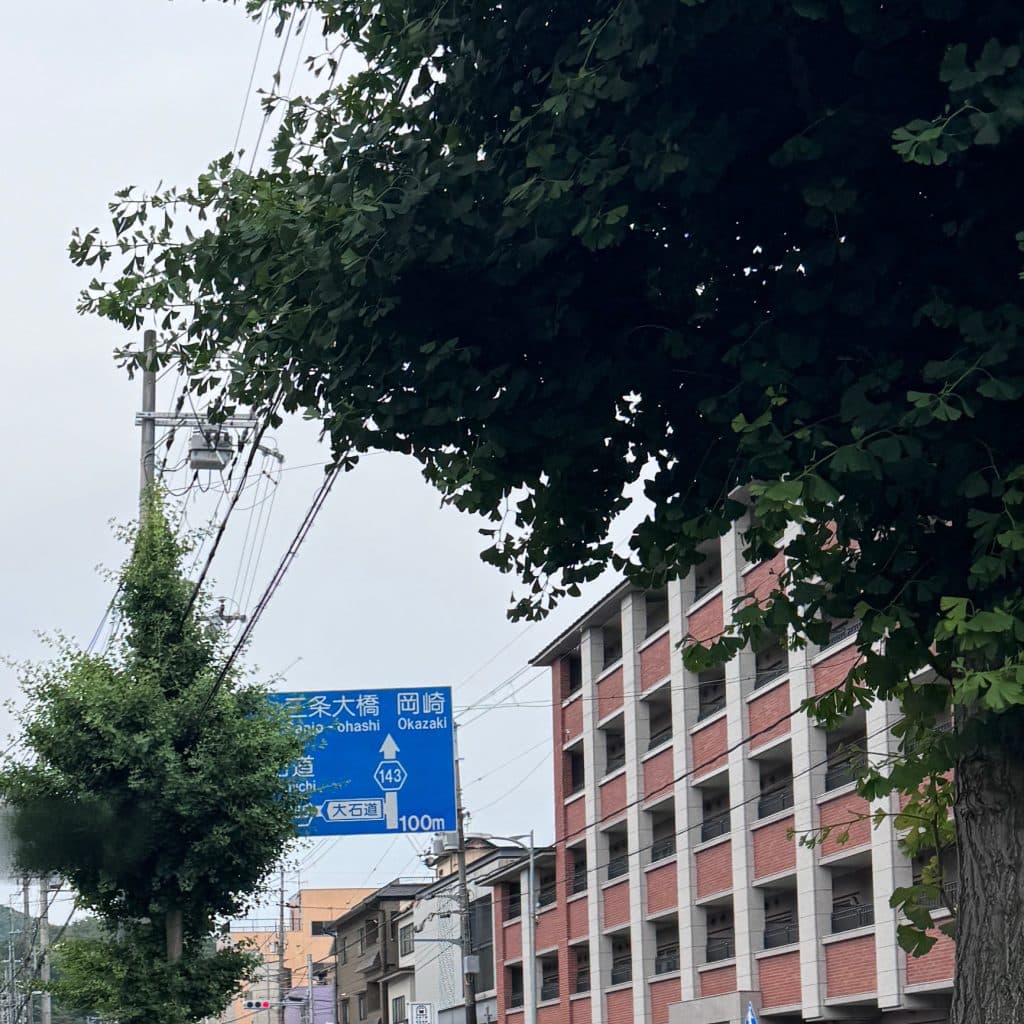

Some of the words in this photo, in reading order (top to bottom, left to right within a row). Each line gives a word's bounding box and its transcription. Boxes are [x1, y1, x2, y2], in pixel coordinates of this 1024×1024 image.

[285, 693, 380, 718] 三条大橋
[397, 691, 446, 715] 岡崎
[397, 716, 447, 730] Okazaki
[379, 768, 402, 784] 143
[332, 803, 378, 818] 大石道
[399, 814, 445, 832] 100m
